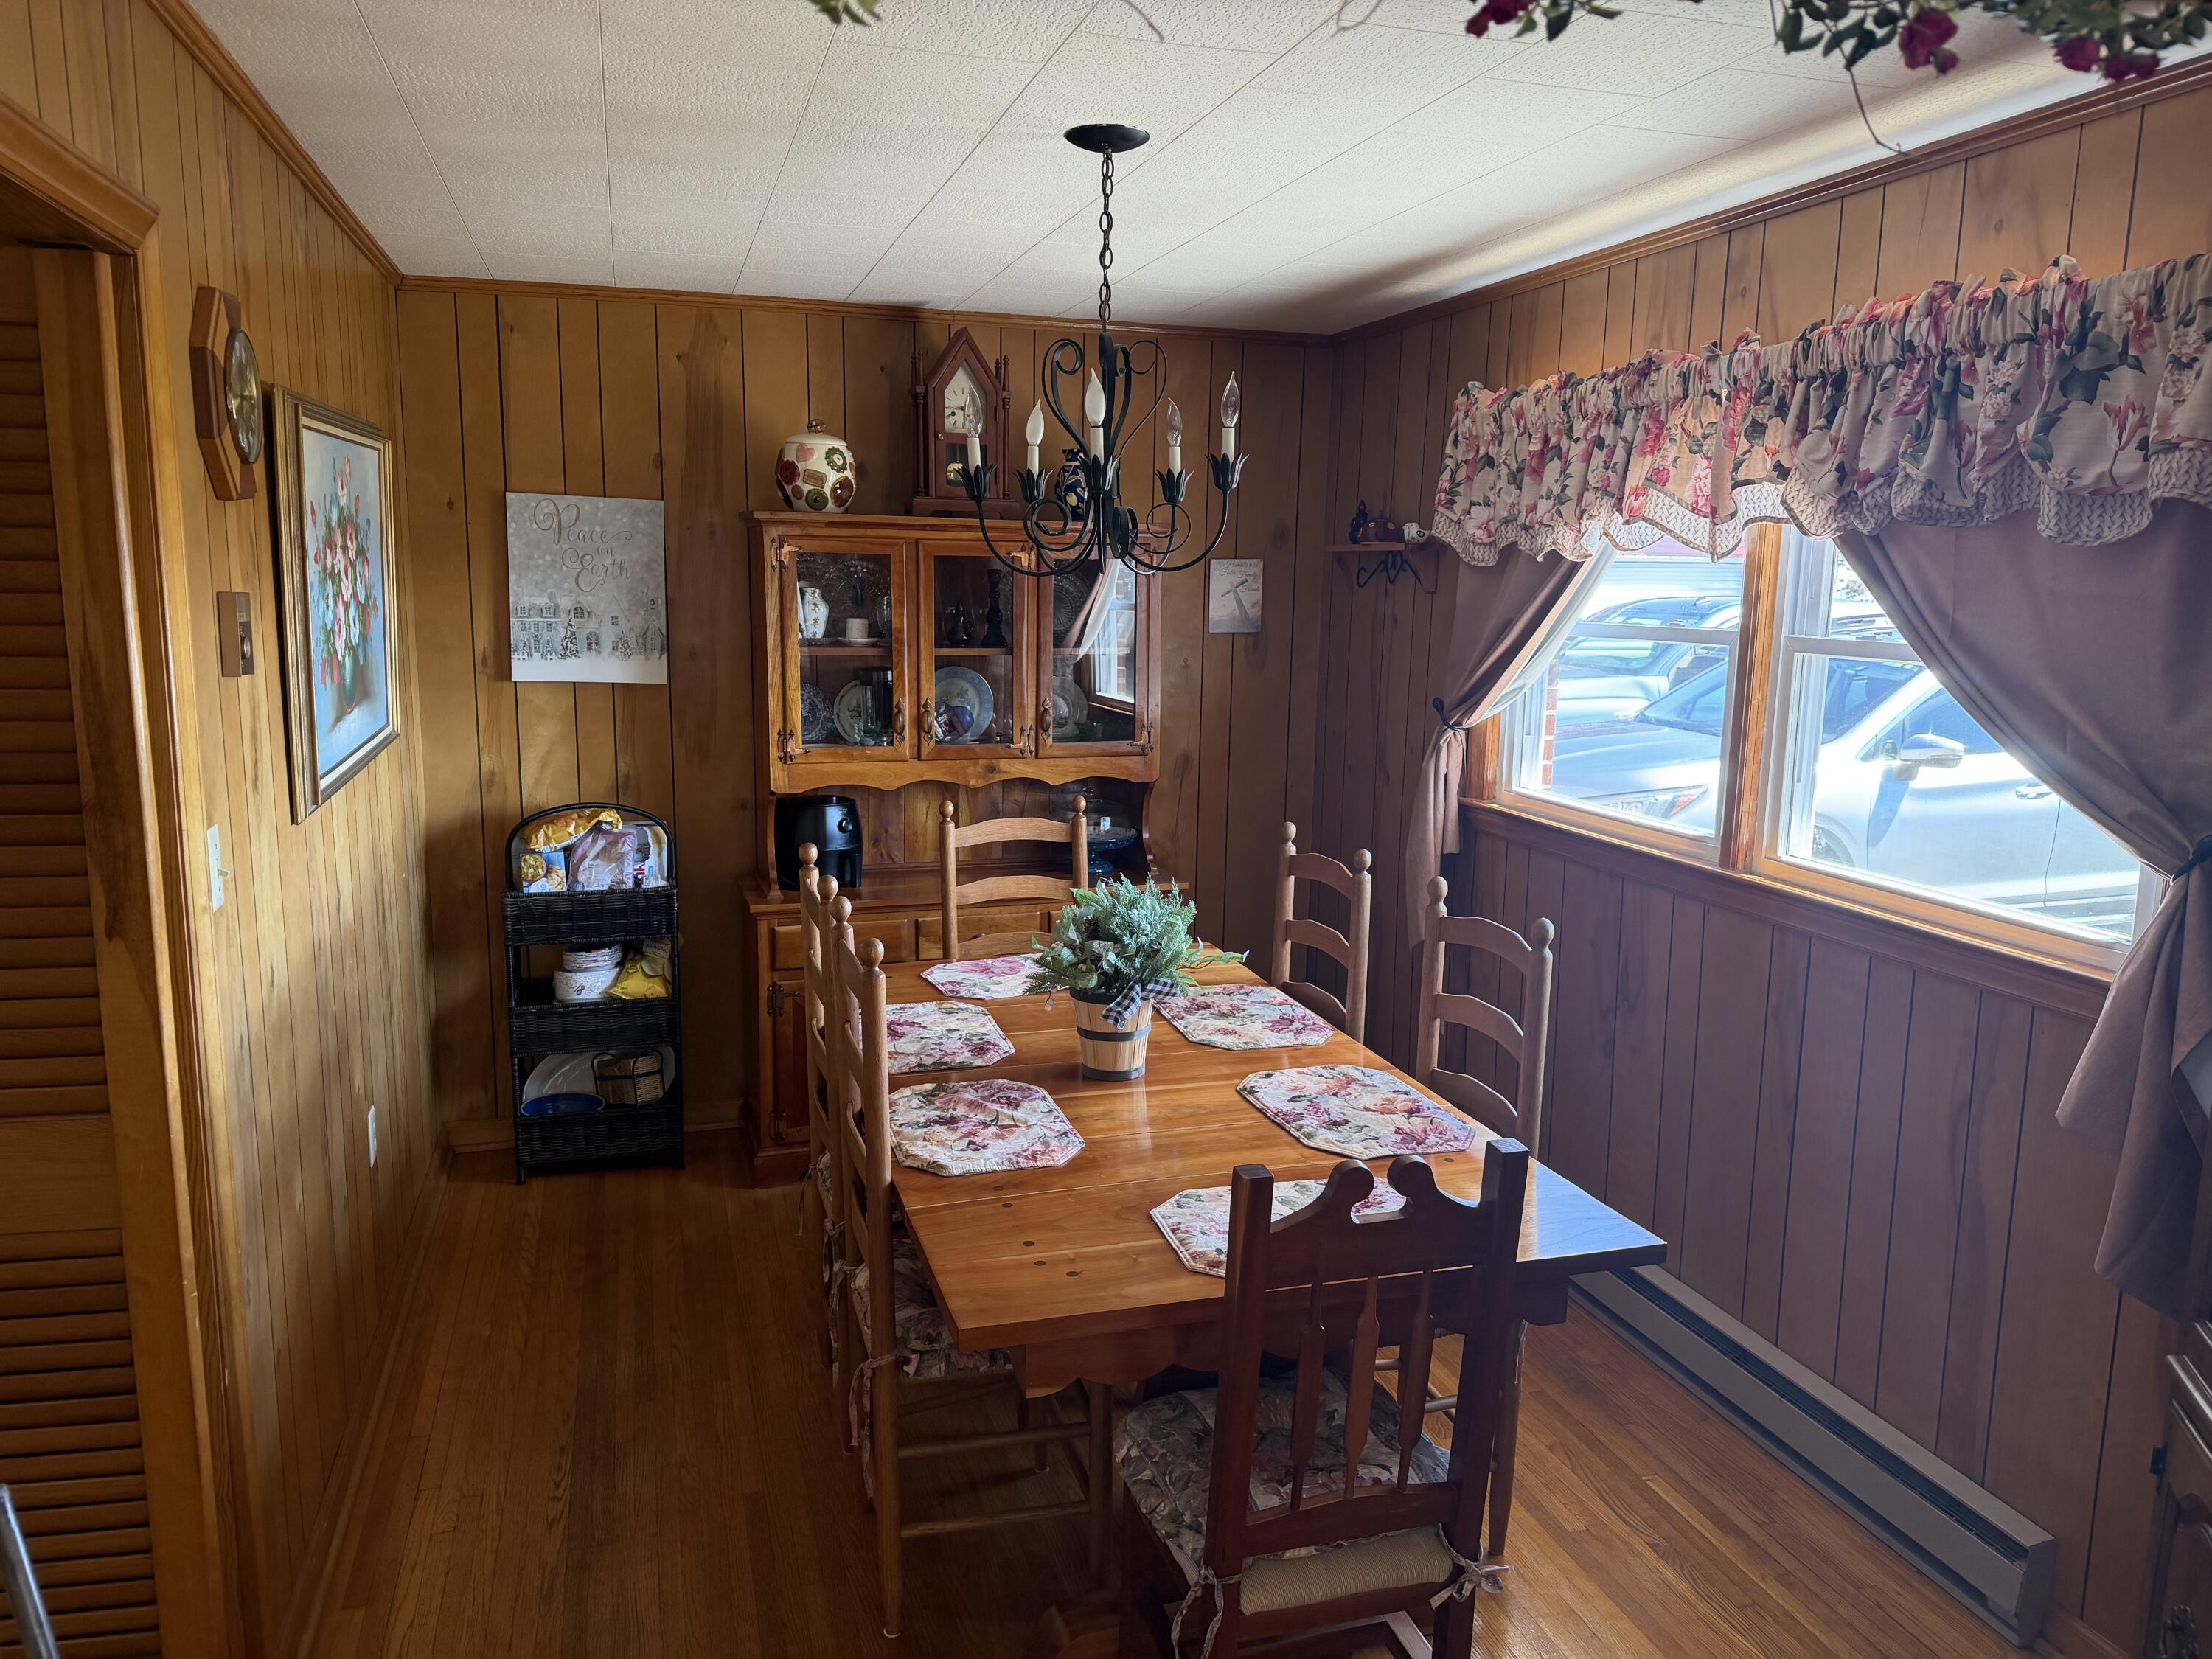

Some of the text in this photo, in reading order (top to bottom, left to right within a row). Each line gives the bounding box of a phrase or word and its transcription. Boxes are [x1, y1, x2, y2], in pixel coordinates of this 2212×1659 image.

[533, 498, 633, 546] Peace
[597, 544, 616, 557] on
[561, 548, 632, 592] Earth
[646, 943, 668, 954] CLASSIC
